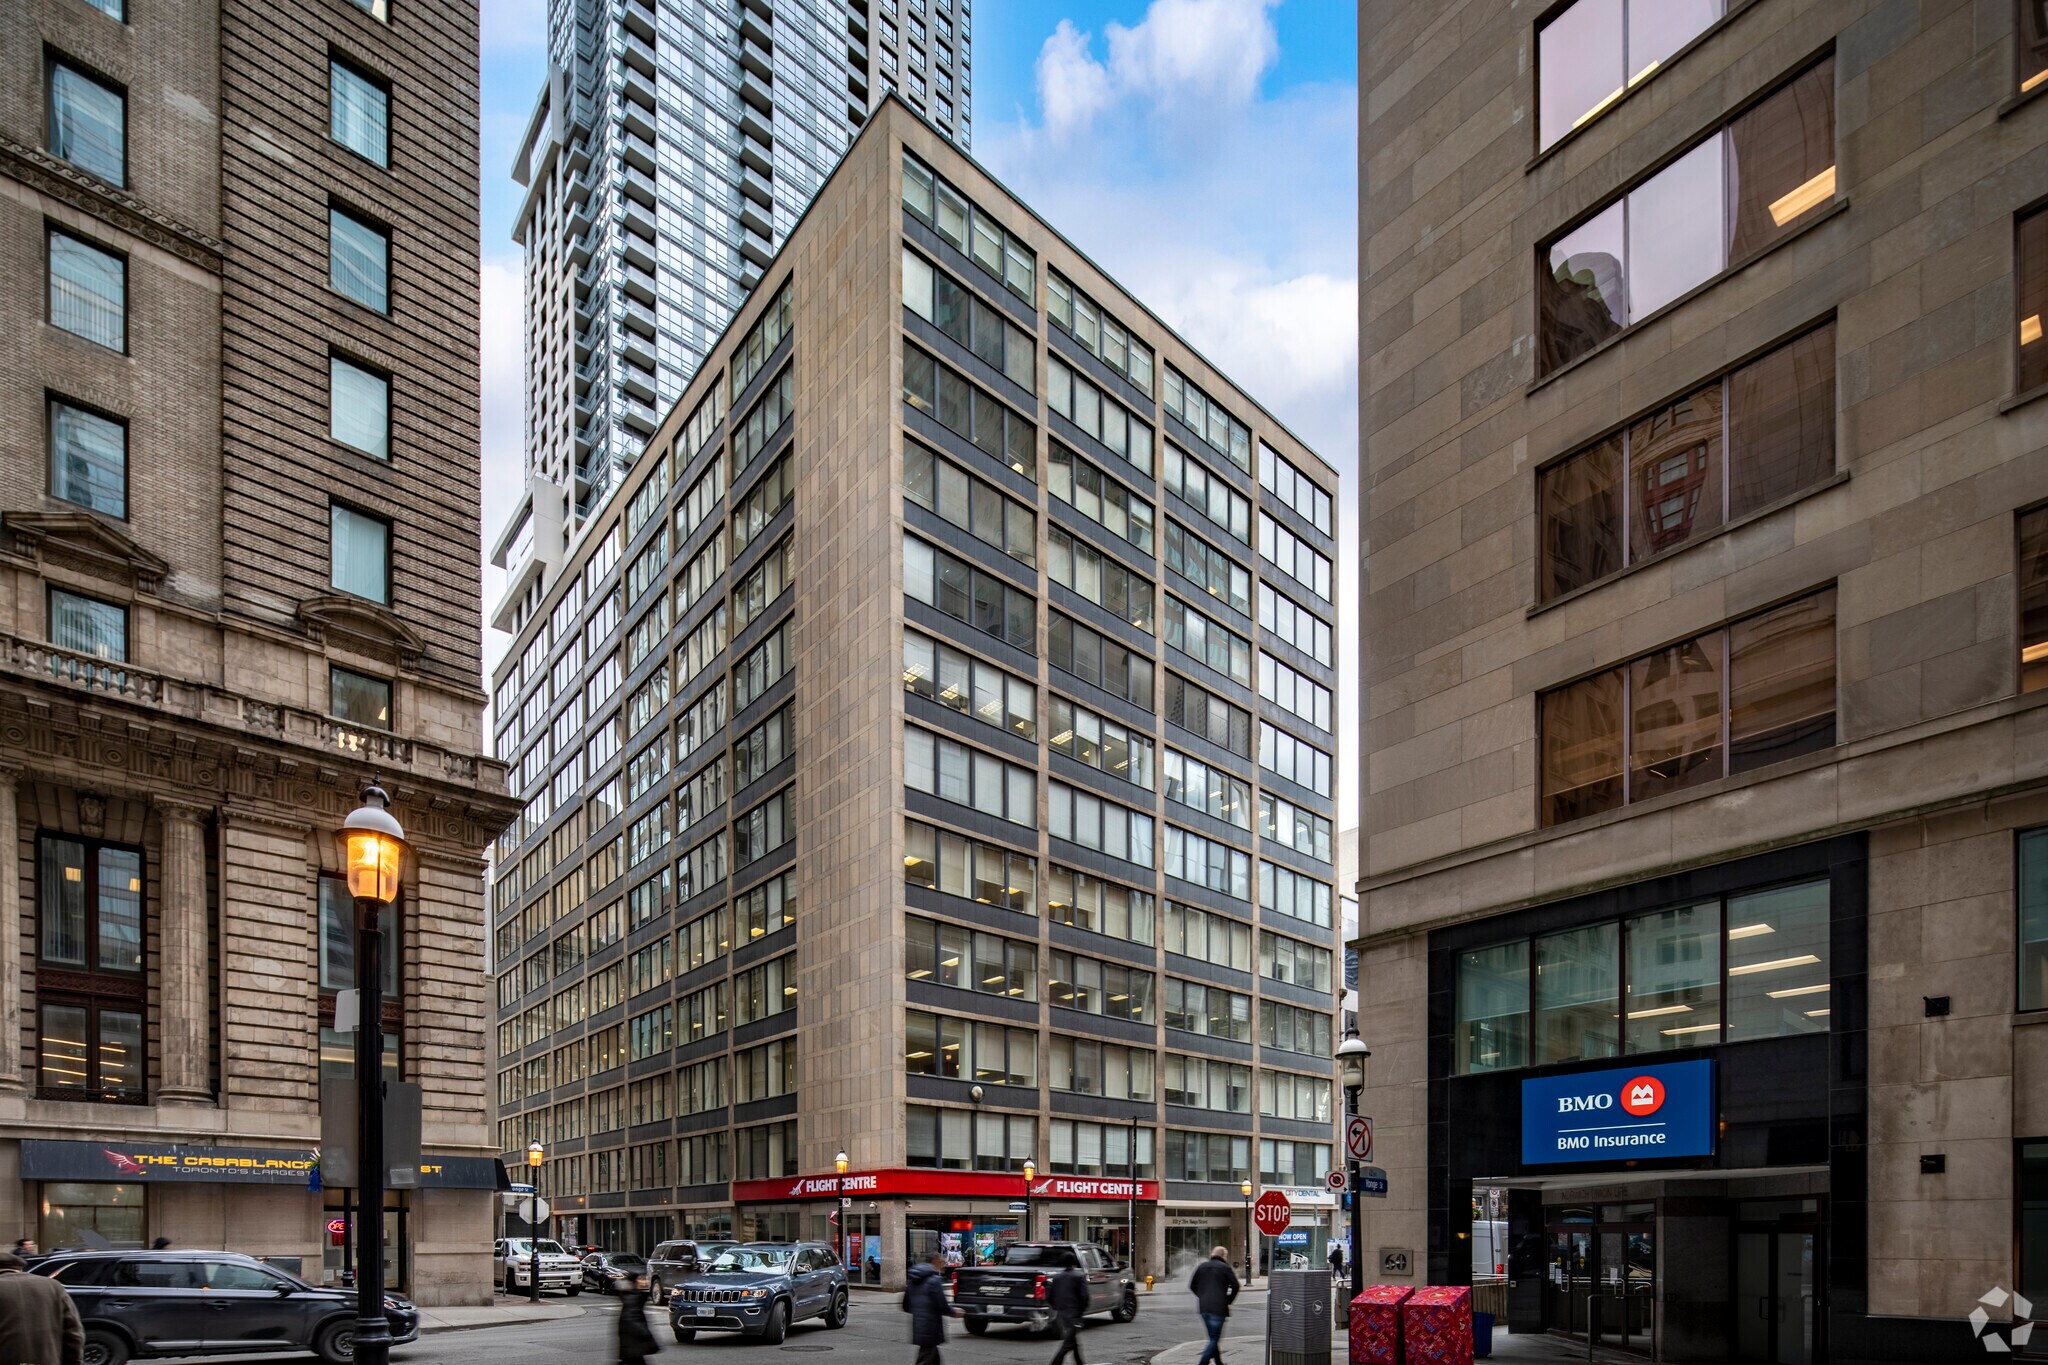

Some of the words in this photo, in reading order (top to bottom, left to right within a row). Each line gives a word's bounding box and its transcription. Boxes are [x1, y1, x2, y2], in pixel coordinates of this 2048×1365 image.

[1557, 1093, 1613, 1113] BMO
[1557, 1136, 1590, 1150] BMO
[1594, 1133, 1666, 1148] Insurance
[133, 1155, 178, 1166] THE
[172, 1166, 249, 1175] TORONTO'S
[252, 1169, 312, 1177] LARGEST
[806, 1178, 839, 1193] FLIGHT
[1056, 1180, 1099, 1194] FLIGHT
[1256, 1204, 1290, 1222] STOP
[331, 1222, 345, 1230] OPE
[1278, 1233, 1292, 1241] NOW
[1292, 1233, 1307, 1241] OPEN
[1384, 1253, 1407, 1271] 60
